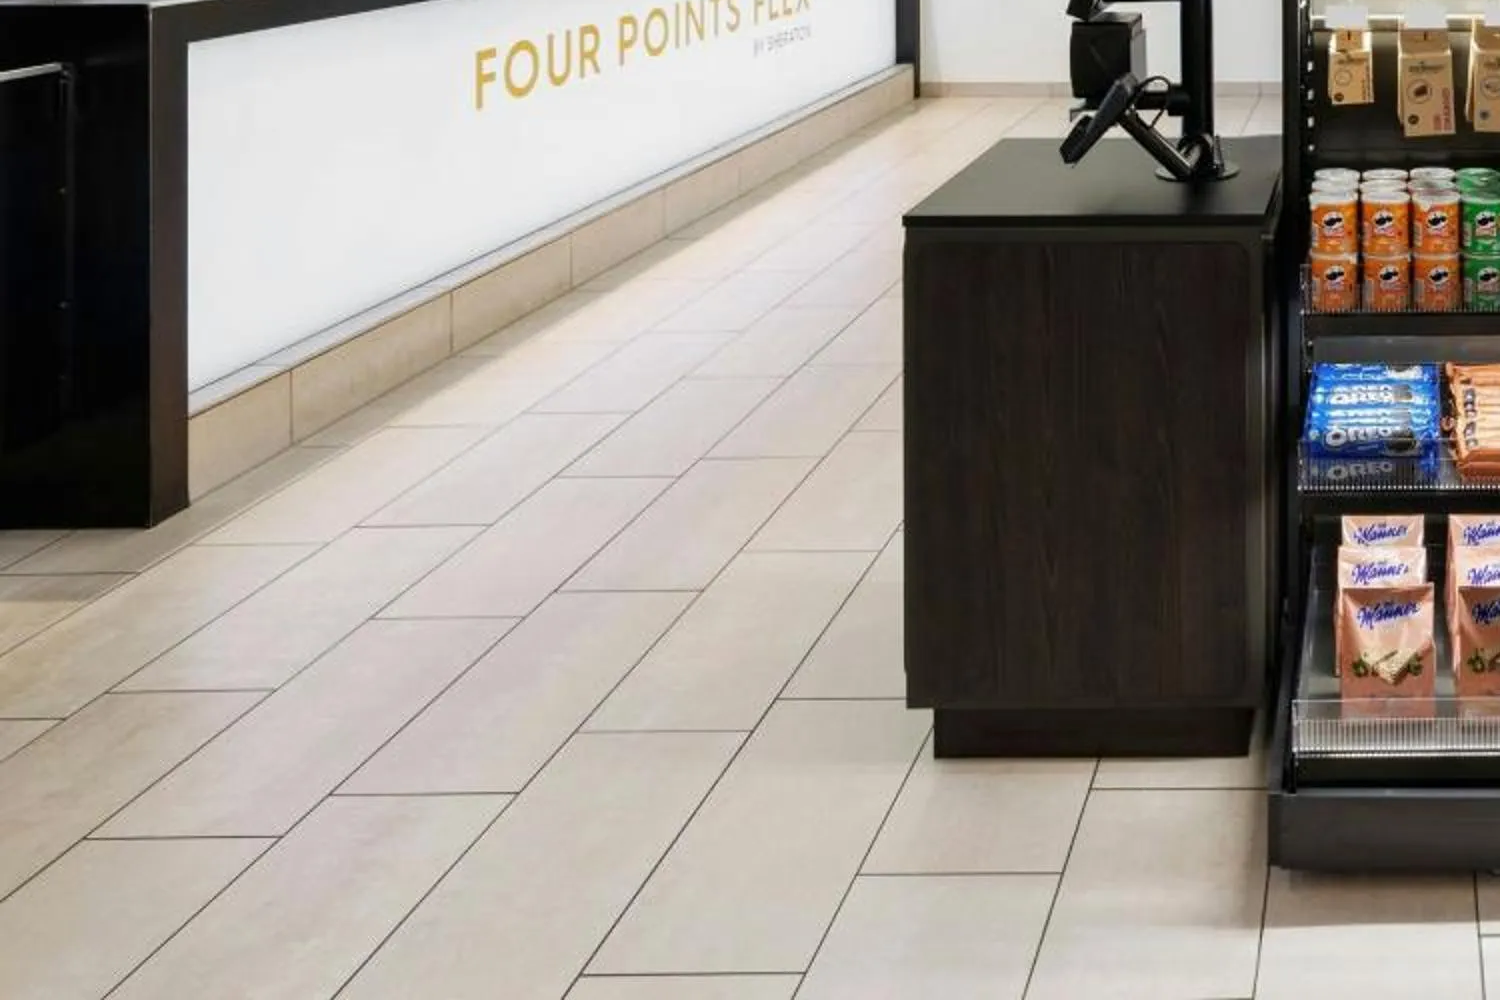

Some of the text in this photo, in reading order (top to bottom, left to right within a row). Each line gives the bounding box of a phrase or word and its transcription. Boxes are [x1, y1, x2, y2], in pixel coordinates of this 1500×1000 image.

[475, 24, 601, 111] FOUR
[1326, 427, 1393, 446] OREO
[1352, 562, 1409, 585] Manner
[1357, 601, 1421, 630] Manner
